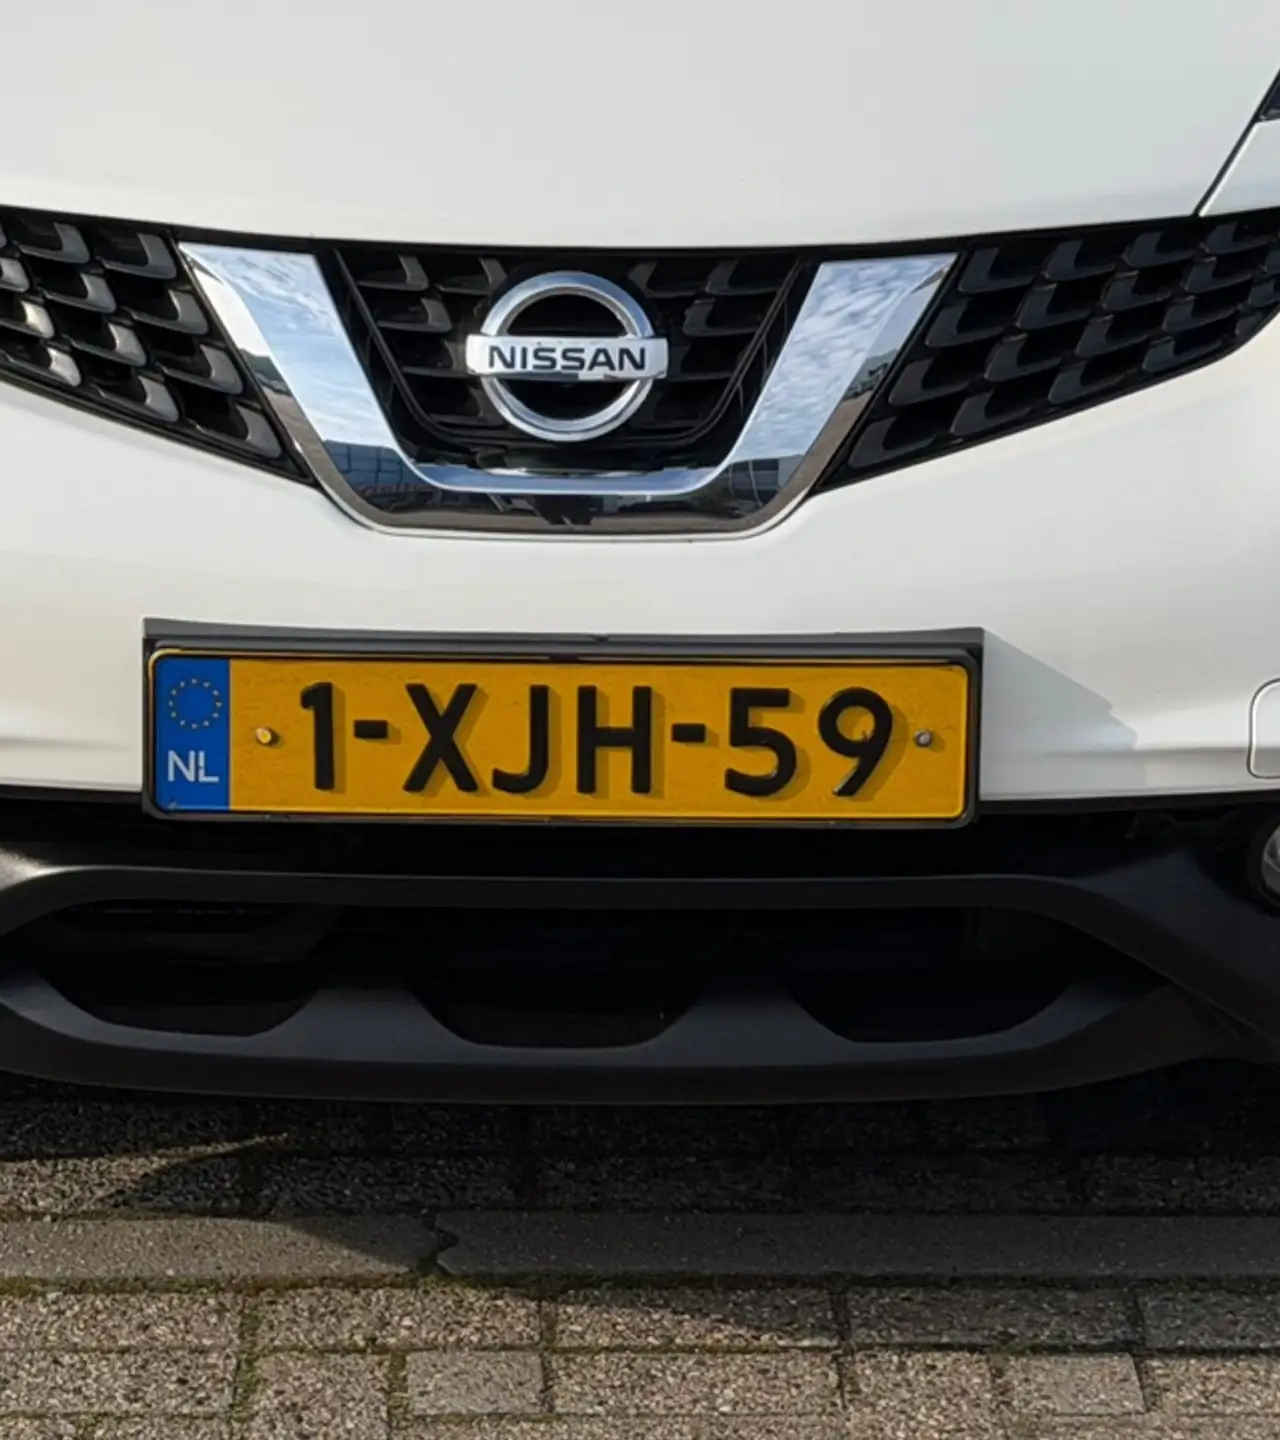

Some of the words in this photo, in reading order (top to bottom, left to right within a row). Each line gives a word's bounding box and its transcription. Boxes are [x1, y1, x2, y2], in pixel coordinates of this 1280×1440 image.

[489, 345, 646, 371] NISSAN
[300, 680, 894, 798] 1-XJH-59
[167, 749, 219, 784] NL
